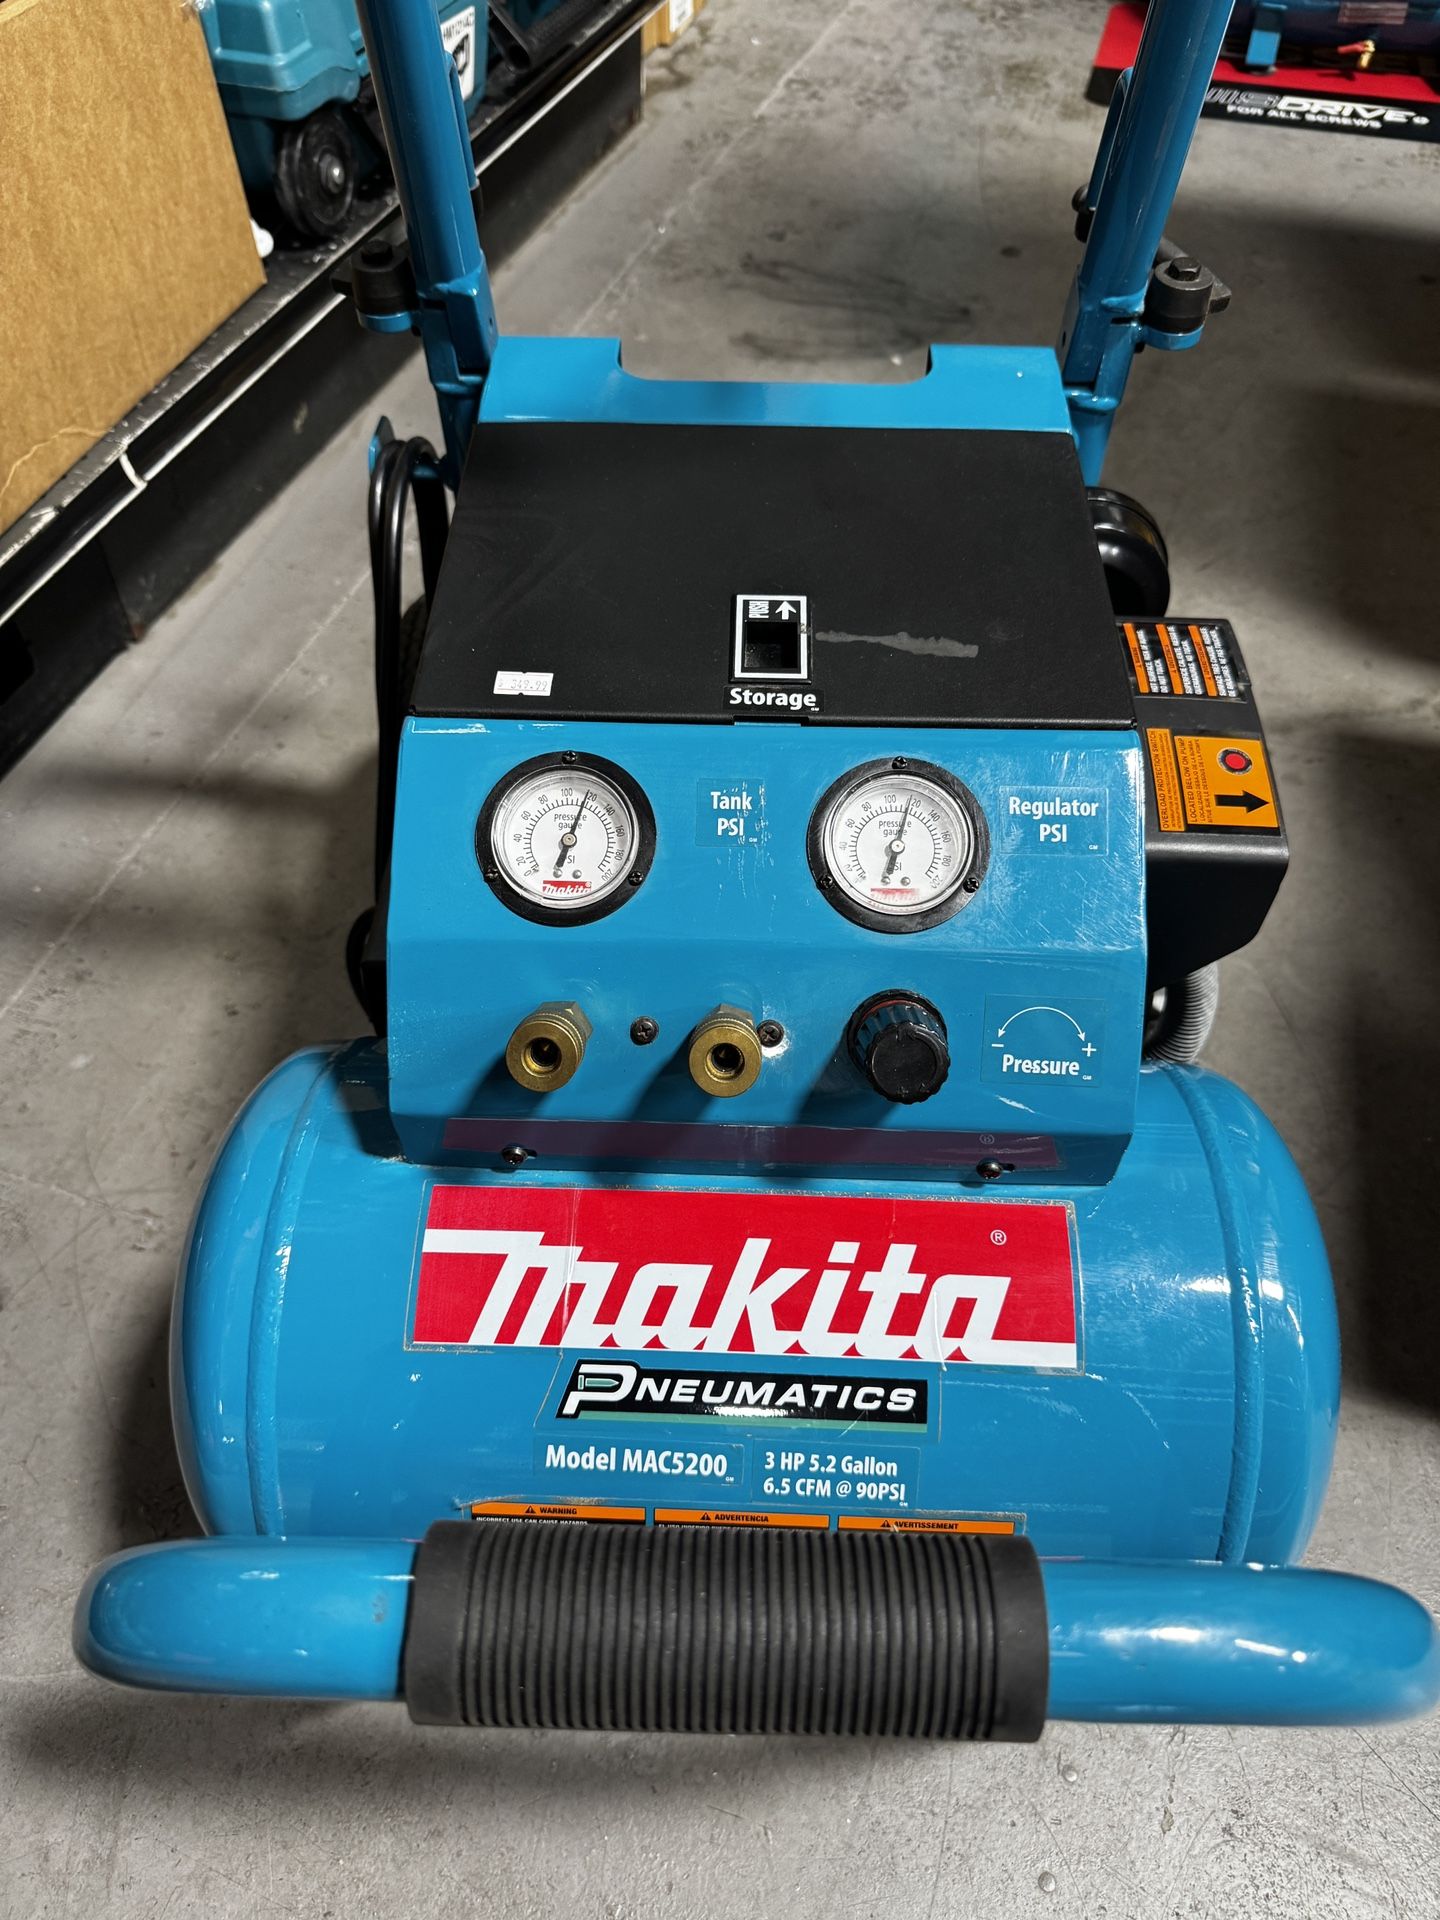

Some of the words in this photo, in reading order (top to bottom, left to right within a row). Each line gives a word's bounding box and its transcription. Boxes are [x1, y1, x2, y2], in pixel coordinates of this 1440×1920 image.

[1305, 112, 1382, 129] SCREWS
[749, 601, 769, 618] PUSH
[729, 687, 817, 710] Storage
[1182, 756, 1188, 765] ON
[1154, 754, 1164, 793] PROTECTION
[1184, 766, 1192, 790] BELOW
[538, 794, 548, 804] 80
[561, 788, 573, 797] 100
[711, 791, 752, 809] Tank
[884, 794, 896, 804] 100
[521, 810, 531, 820] 60
[604, 804, 616, 816] 140
[862, 802, 872, 812] 80
[1009, 796, 1099, 820] Regulator
[1159, 794, 1169, 829] OVERLOAD
[1187, 791, 1197, 822] LOCATED
[928, 810, 940, 822] 140
[558, 822, 582, 830] gaue
[615, 825, 625, 838] 160
[717, 818, 744, 835] PSI
[883, 829, 908, 837] gaue
[1040, 824, 1067, 842] PSI
[514, 833, 522, 842] 40
[614, 848, 624, 860] 180
[1002, 1054, 1080, 1076] Pressure
[421, 1229, 1077, 1368] makita
[562, 1363, 917, 1414] PNEUMATICS
[545, 1444, 616, 1471] Model
[622, 1448, 728, 1477] MAC5200
[764, 1452, 775, 1470] 3
[780, 1452, 806, 1472] HP
[809, 1454, 836, 1474] 5.2
[841, 1455, 898, 1477] Gallon
[764, 1477, 790, 1495] 6.5
[795, 1478, 831, 1498] CFM
[836, 1480, 852, 1498] @
[856, 1482, 906, 1502] 90PSI
[540, 1507, 578, 1515] WARNING
[714, 1514, 768, 1522] ADVERTENCIA
[894, 1521, 958, 1530] AVERTISSEMENT
